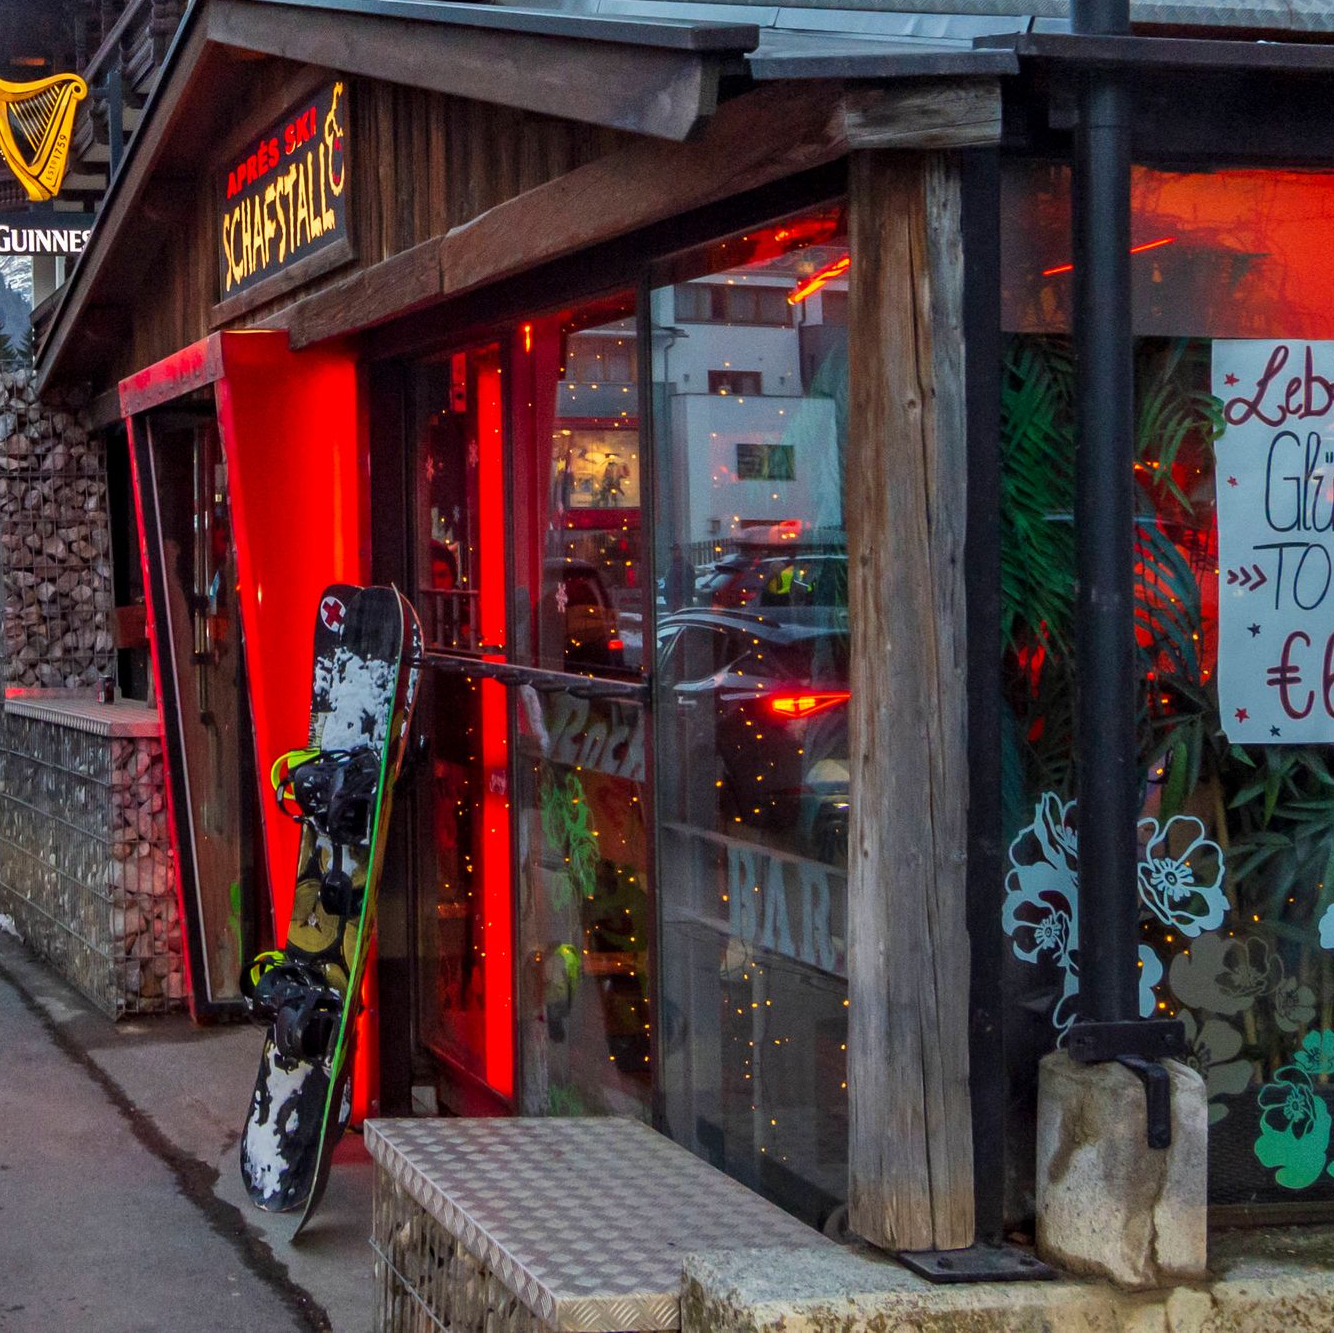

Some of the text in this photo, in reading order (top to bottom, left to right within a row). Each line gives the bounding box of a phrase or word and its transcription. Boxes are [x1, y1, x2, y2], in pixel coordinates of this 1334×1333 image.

[227, 106, 317, 200] APRÉS SKI
[223, 142, 336, 292] SCHAFSTALL
[1253, 541, 1332, 611] TO
[727, 846, 836, 971] BAR
